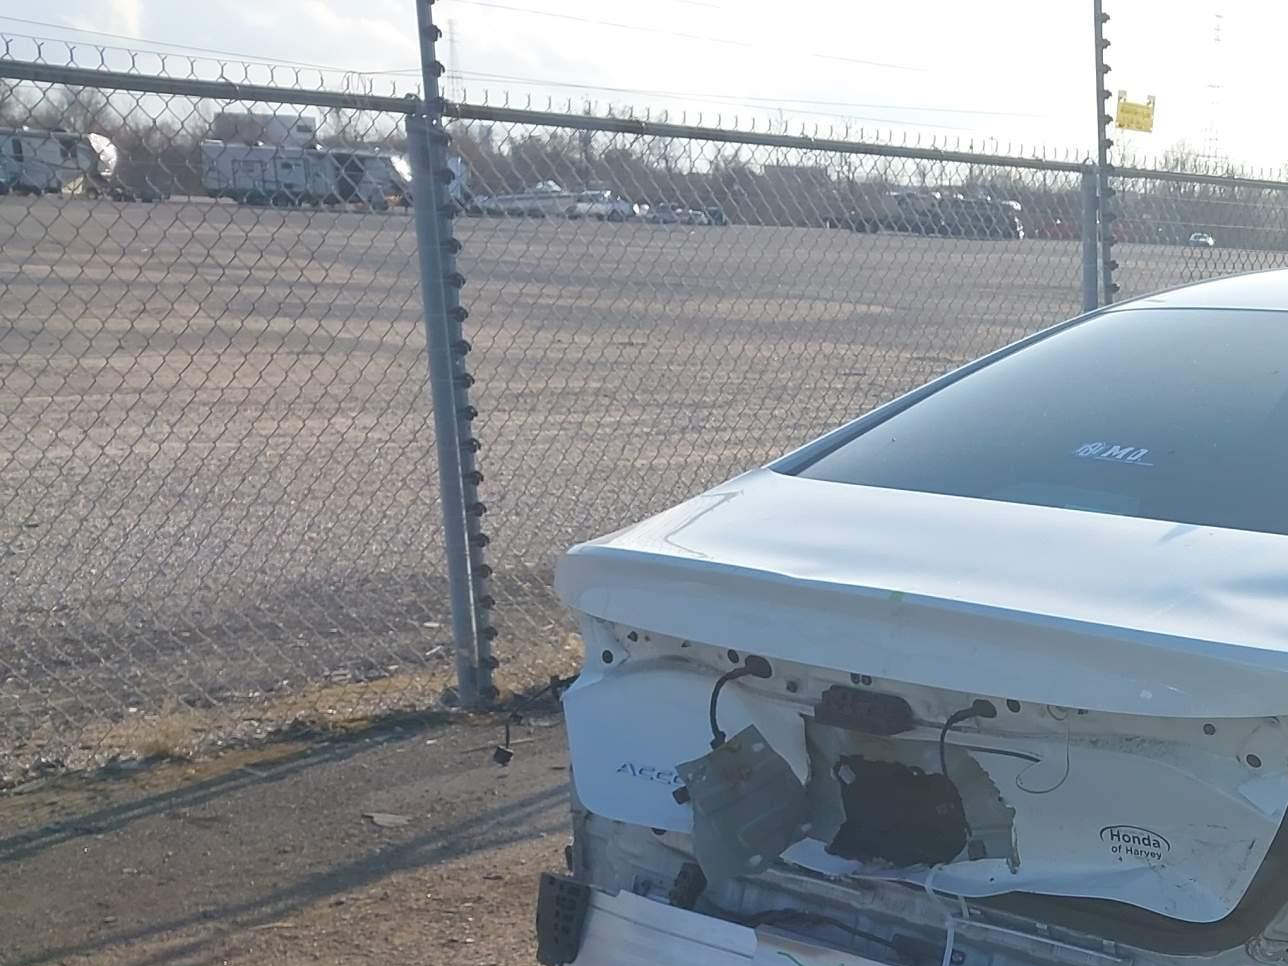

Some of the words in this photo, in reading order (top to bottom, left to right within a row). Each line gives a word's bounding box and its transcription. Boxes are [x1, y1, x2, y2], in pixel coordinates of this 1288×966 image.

[1109, 828, 1161, 848] Honda
[1111, 844, 1122, 853] of
[1125, 846, 1162, 860] Harvey
